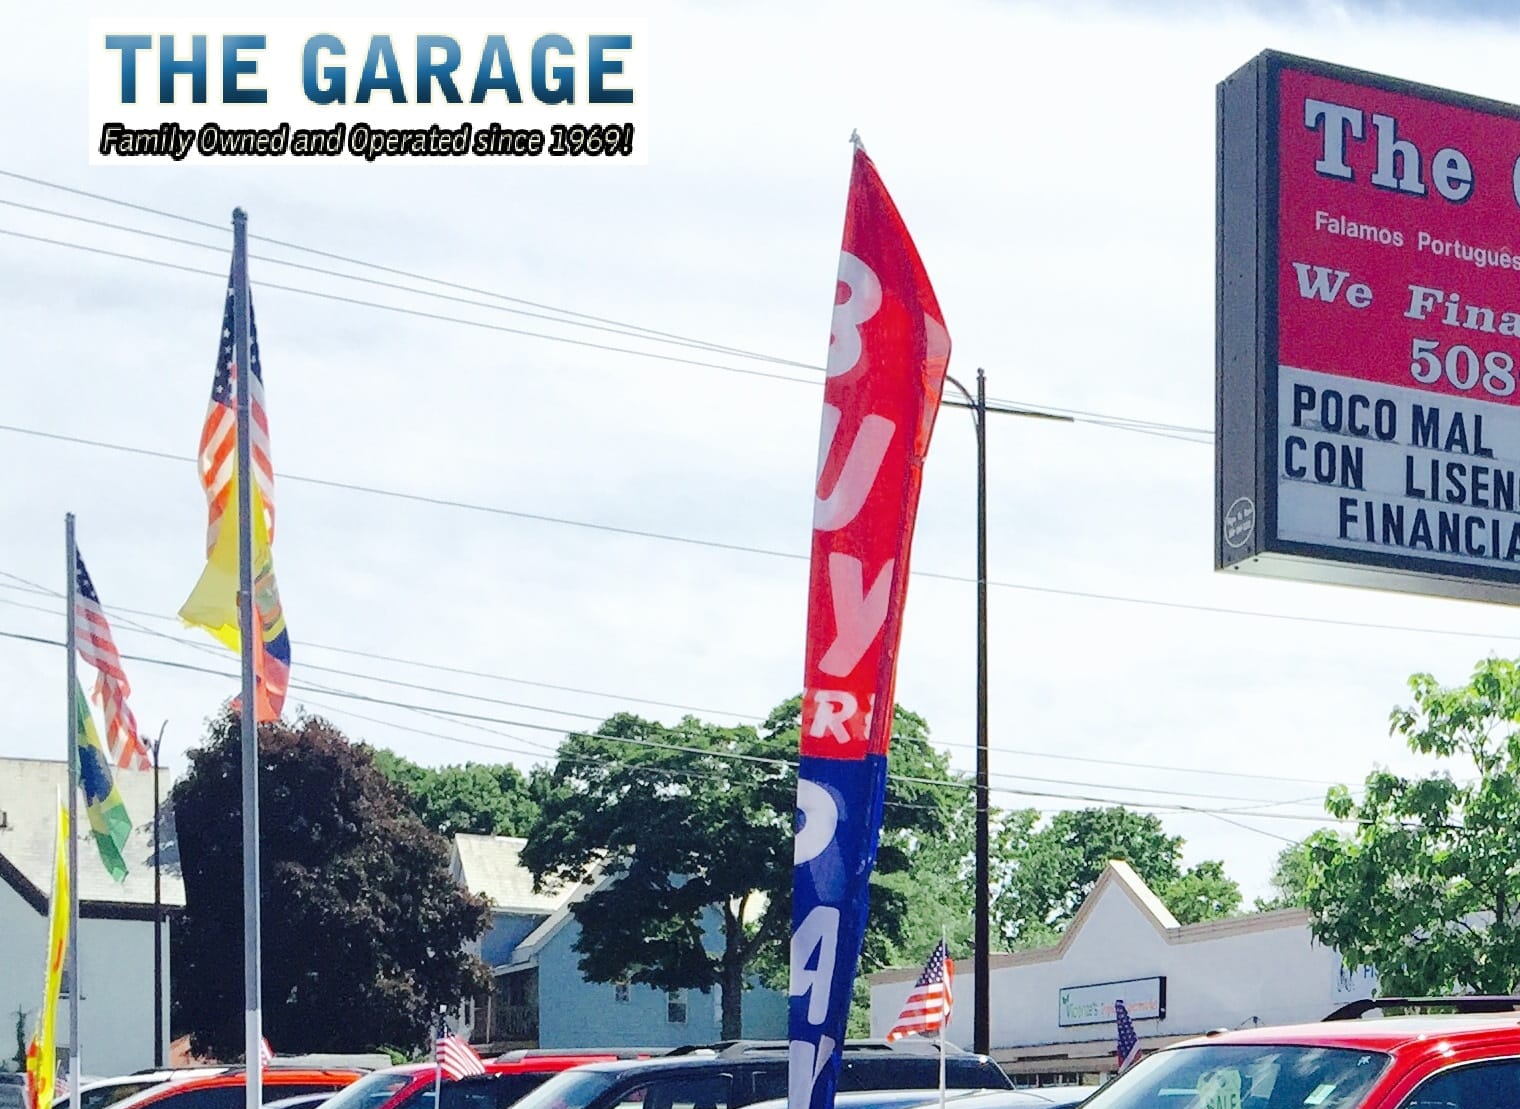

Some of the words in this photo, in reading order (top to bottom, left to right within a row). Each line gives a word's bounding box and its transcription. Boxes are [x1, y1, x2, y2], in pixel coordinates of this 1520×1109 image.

[1304, 98, 1476, 204] The
[1315, 210, 1405, 248] Falamos
[1292, 261, 1374, 309] We
[1293, 384, 1397, 441] POCO
[1411, 404, 1494, 459] MAL
[1284, 435, 1364, 490] CON
